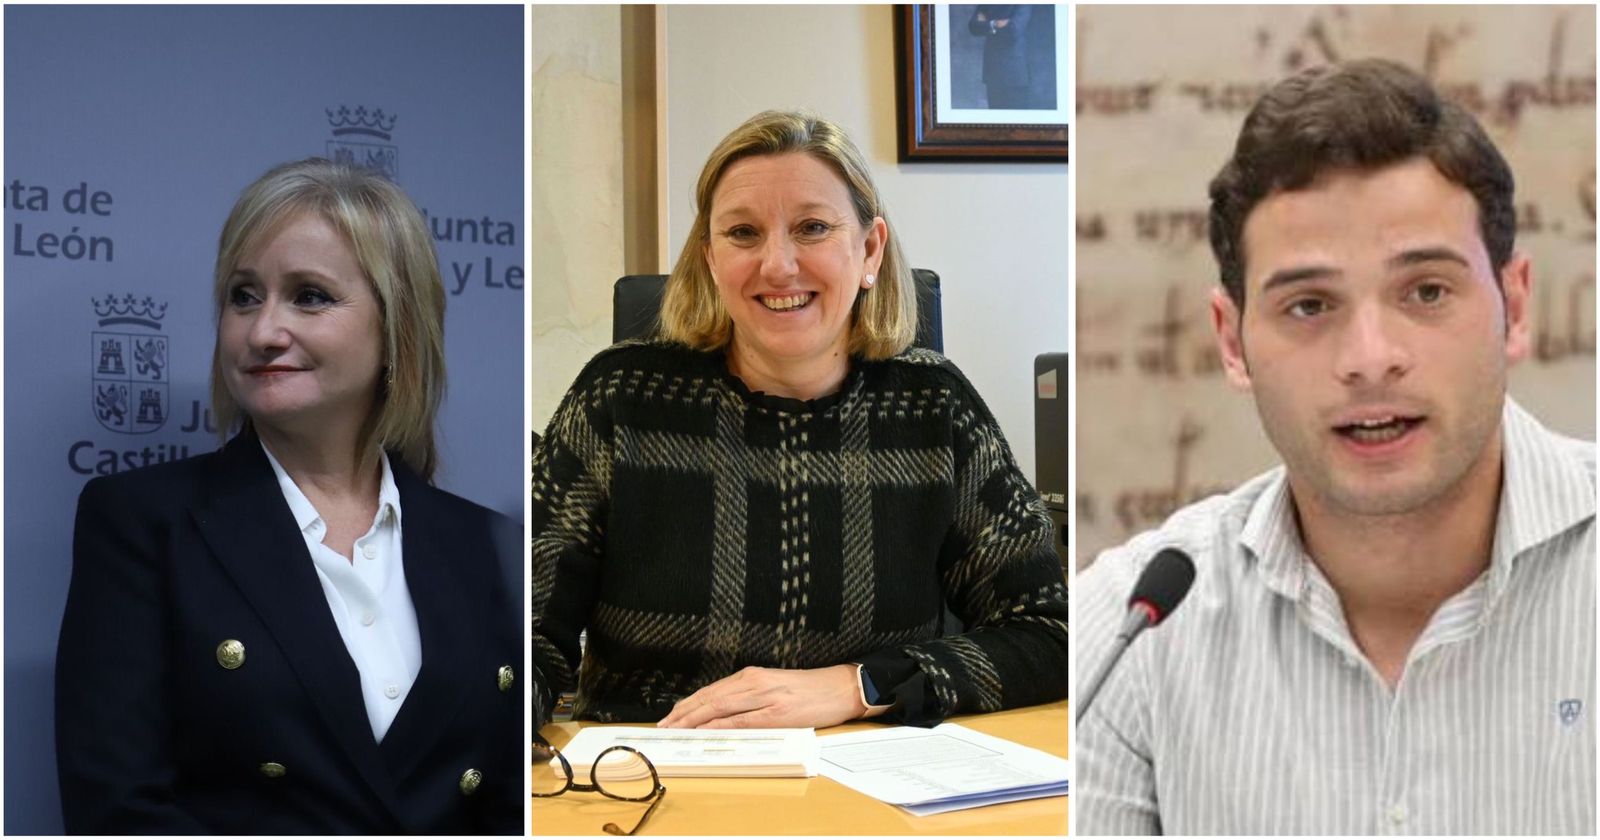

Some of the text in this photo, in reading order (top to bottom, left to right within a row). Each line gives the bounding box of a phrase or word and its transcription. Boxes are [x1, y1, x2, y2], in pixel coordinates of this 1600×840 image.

[4, 179, 113, 216] ta de
[13, 223, 114, 262] León
[422, 208, 515, 246] unta
[450, 261, 473, 296] y
